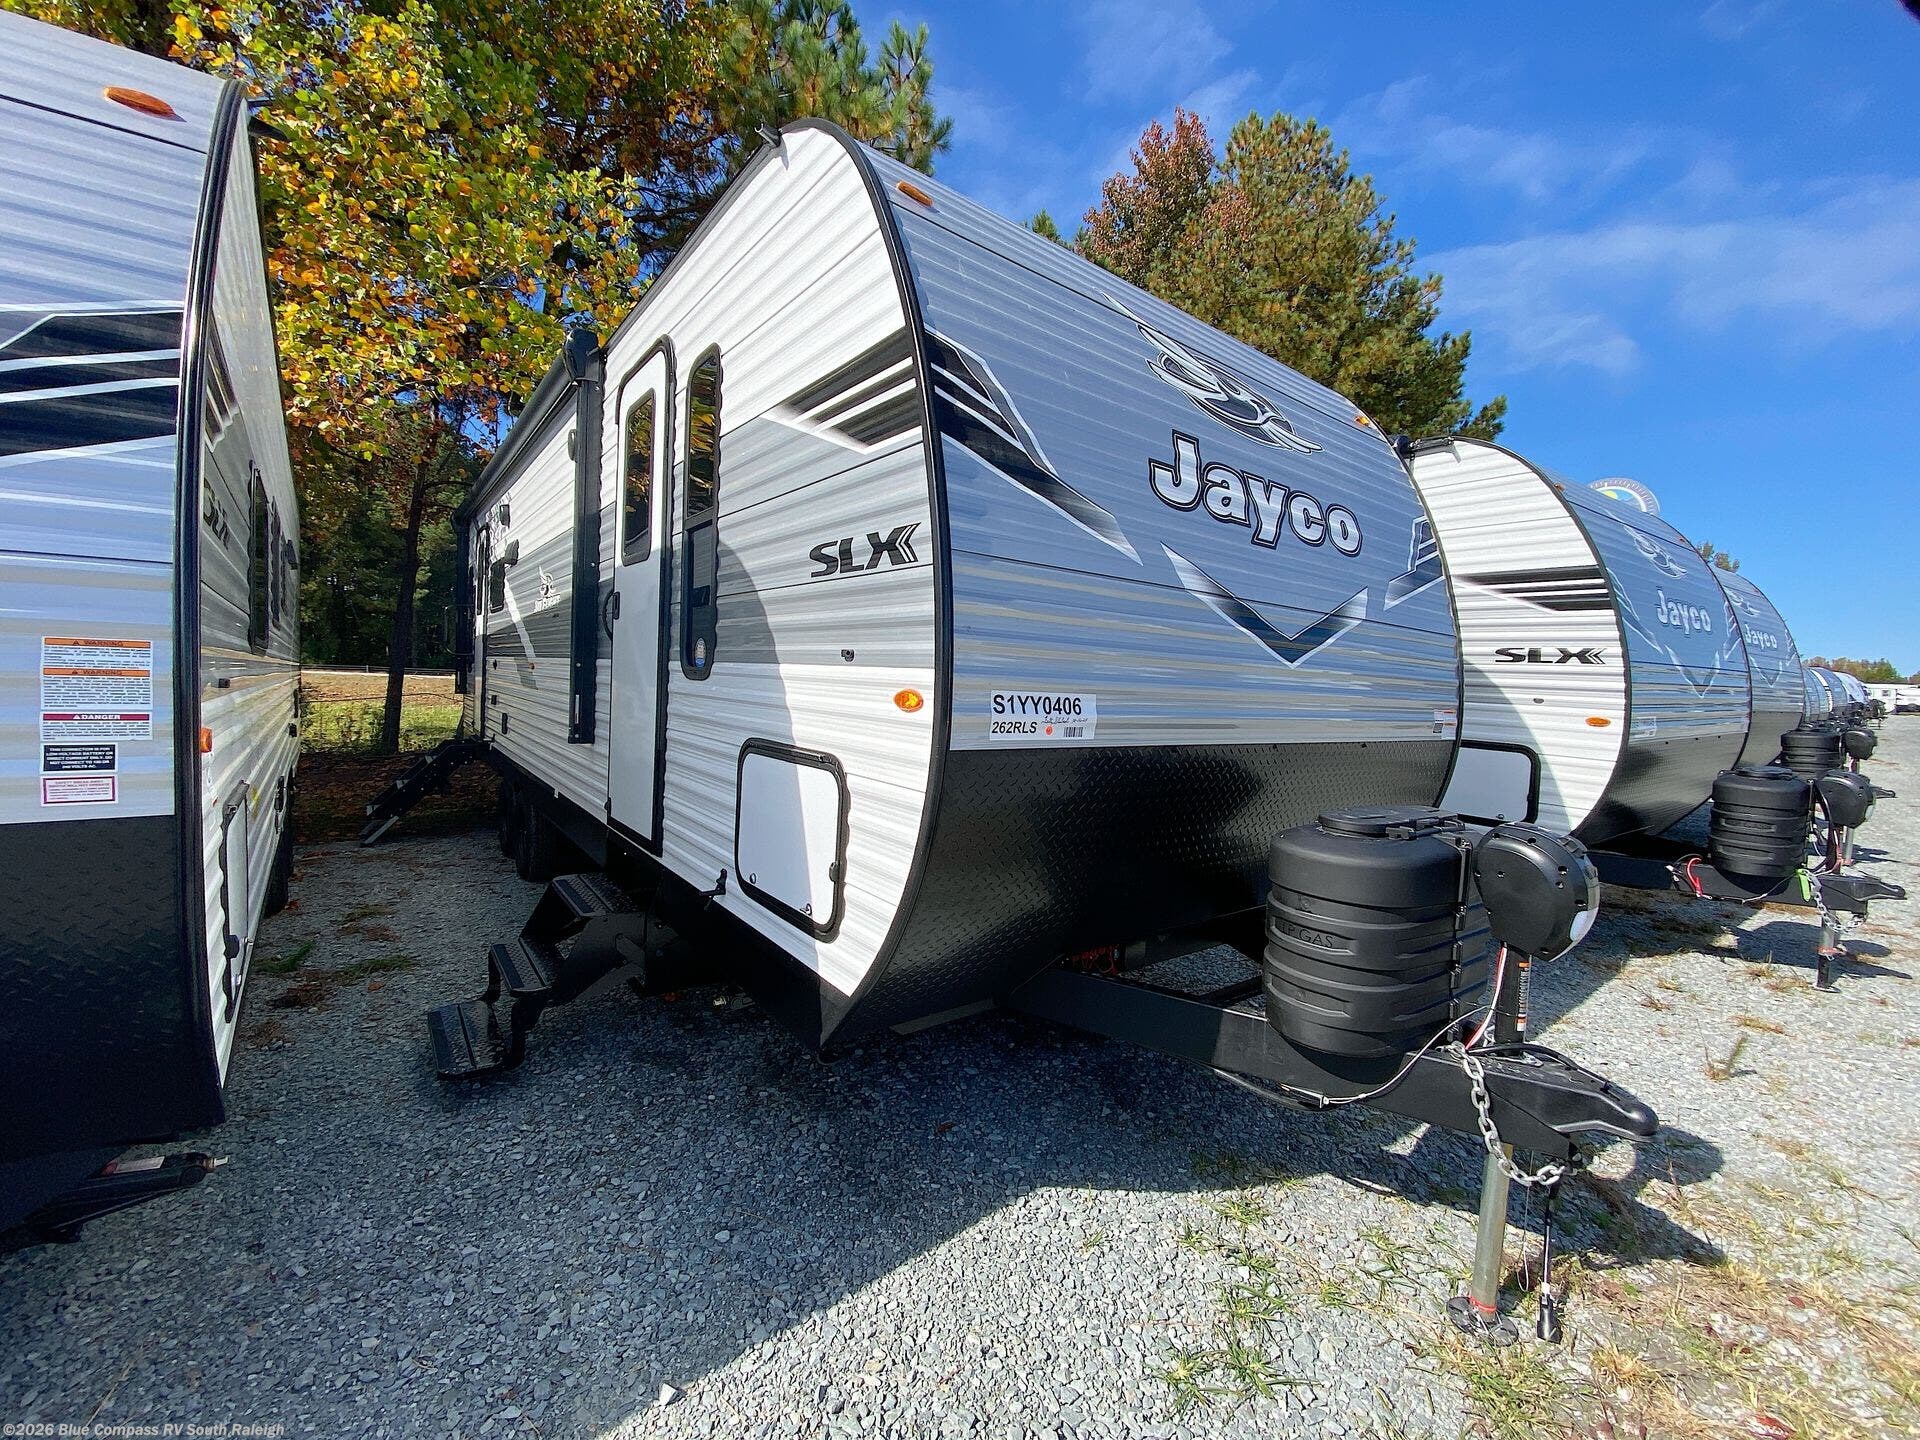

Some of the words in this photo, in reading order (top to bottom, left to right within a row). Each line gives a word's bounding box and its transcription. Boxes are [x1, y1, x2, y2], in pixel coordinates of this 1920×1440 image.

[1149, 429, 1363, 557] Jayco
[809, 522, 921, 578] SLX
[1655, 586, 1712, 638] Jayco
[1744, 622, 1778, 650] Jayco
[1495, 647, 1607, 665] SLX
[992, 694, 1082, 716] S1YY0406
[991, 721, 1038, 734] 262RLS
[1299, 928, 1333, 948] GAS
